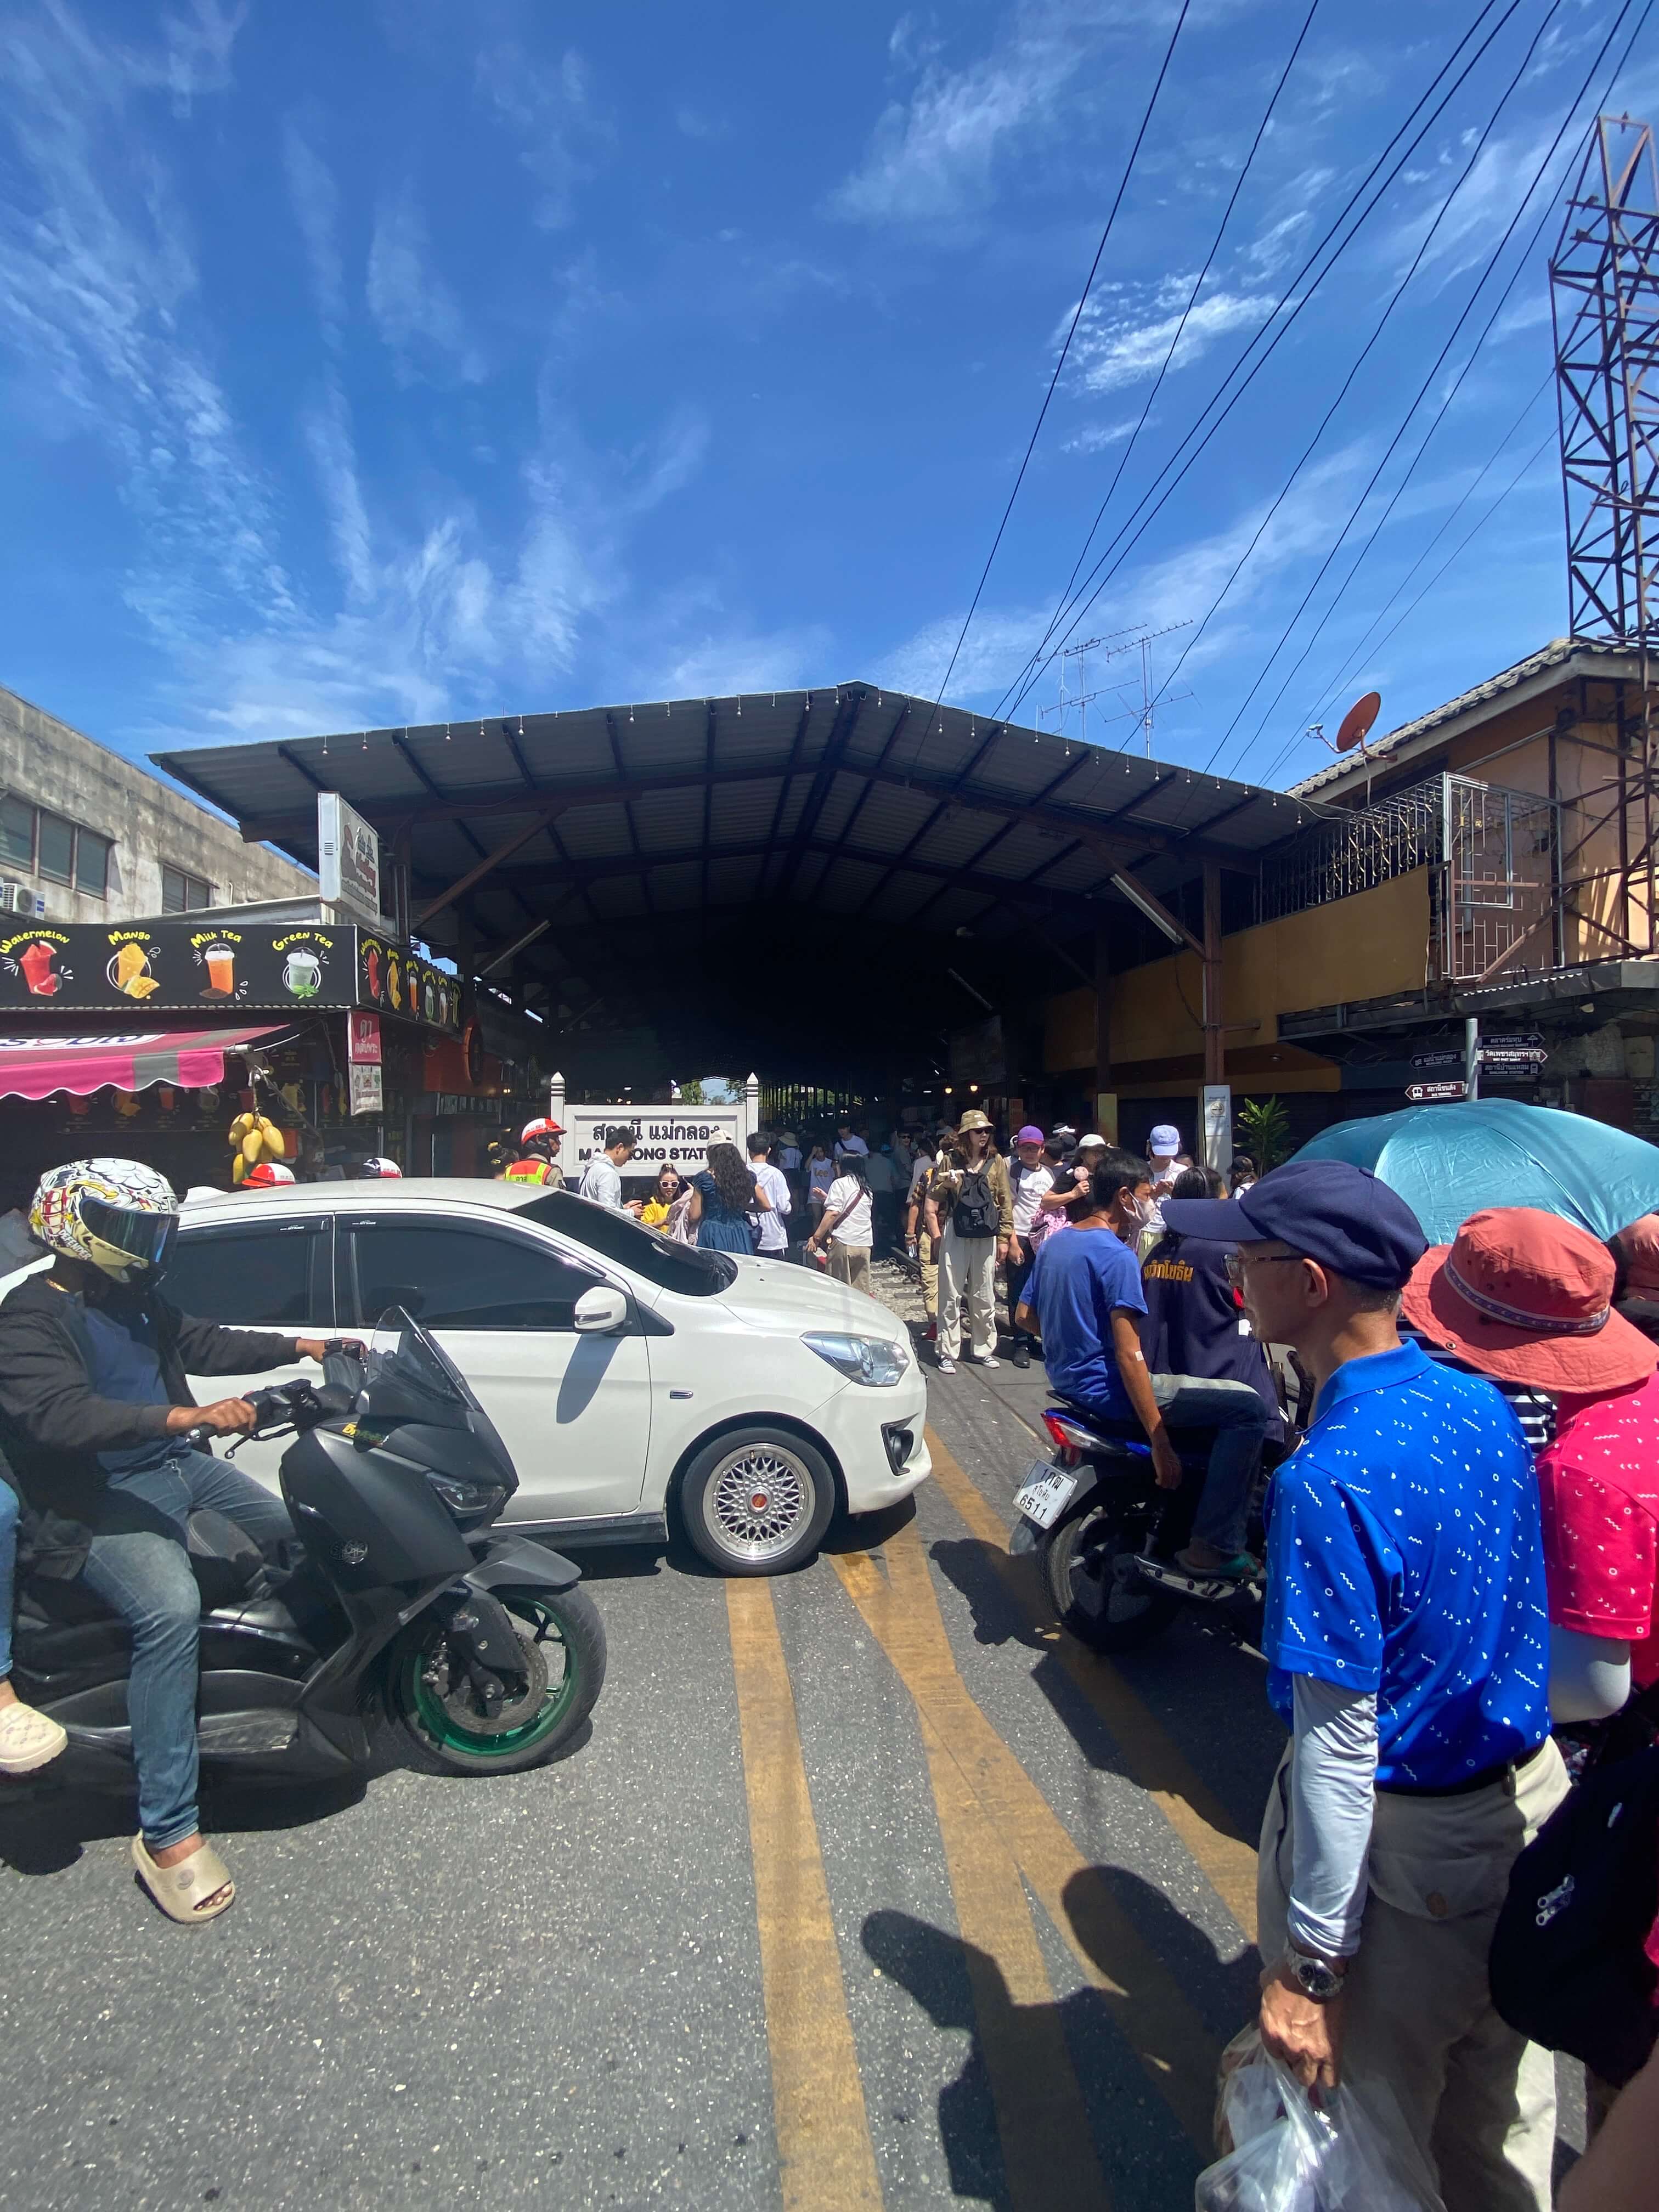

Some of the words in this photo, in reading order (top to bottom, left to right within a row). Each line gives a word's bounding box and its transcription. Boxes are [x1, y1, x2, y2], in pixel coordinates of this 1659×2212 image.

[0, 930, 70, 953] Watermelon
[108, 931, 150, 945] Mango
[190, 932, 217, 948] Milk
[221, 930, 242, 943] Tea
[272, 932, 310, 951] Green
[314, 933, 333, 949] Tea
[58, 1228, 92, 1260] DEFENDER
[1019, 1494, 1047, 1519] 6511
